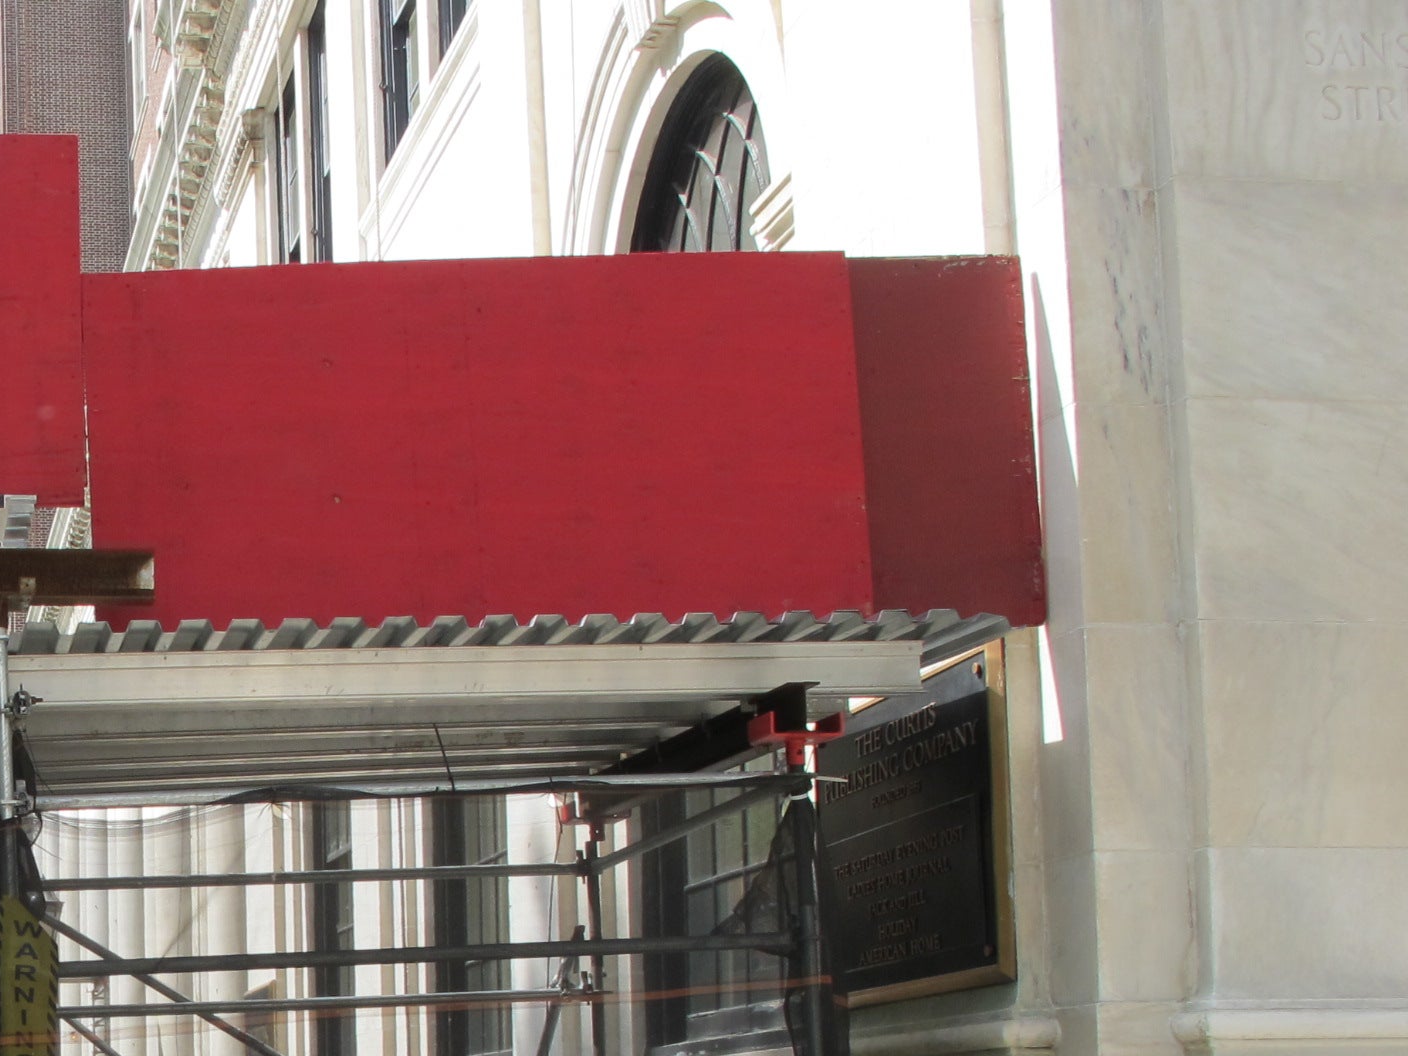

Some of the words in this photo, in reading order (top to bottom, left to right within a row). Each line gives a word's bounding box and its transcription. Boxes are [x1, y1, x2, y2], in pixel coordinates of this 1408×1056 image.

[824, 752, 899, 805] PUBLISHING
[902, 718, 980, 772] COMPANY
[856, 725, 883, 758] THE
[884, 702, 937, 746] CURTIS
